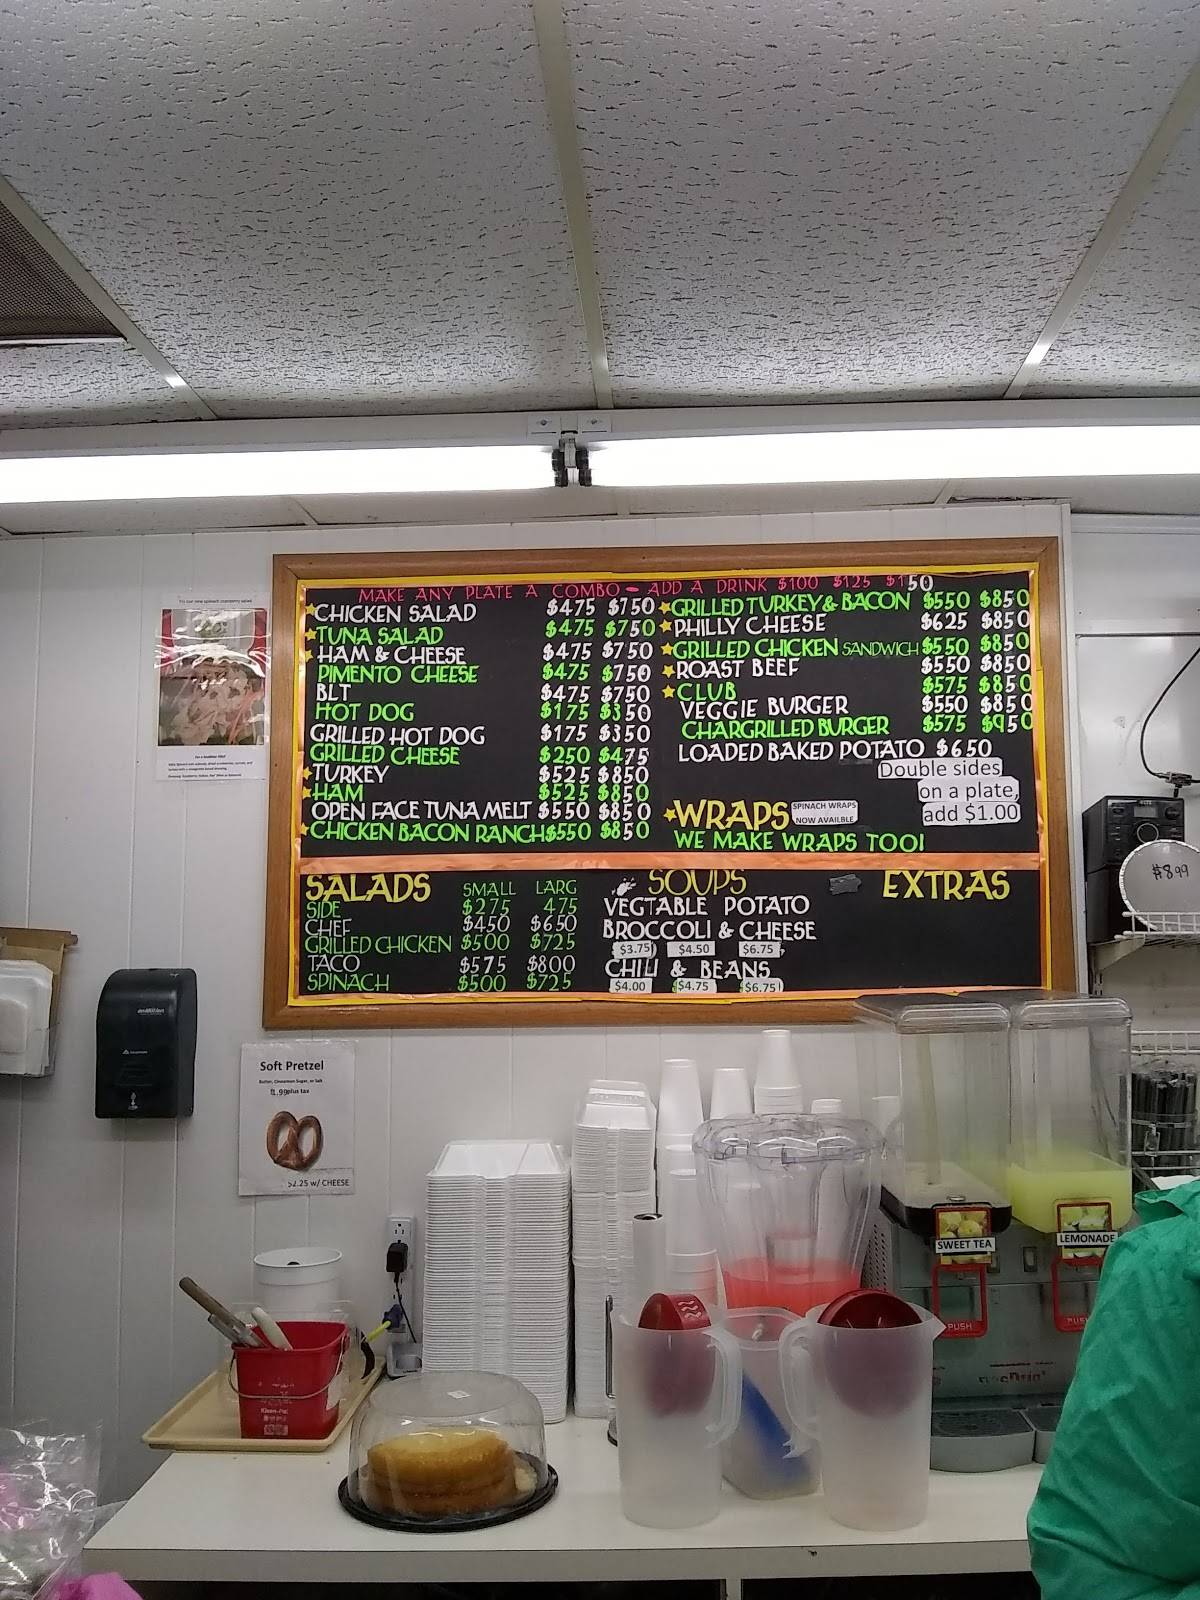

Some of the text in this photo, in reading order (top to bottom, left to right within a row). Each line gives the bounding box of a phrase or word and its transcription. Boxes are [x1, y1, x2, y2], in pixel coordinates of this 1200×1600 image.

[358, 576, 871, 602] MAKE ANY PLATE A COMBO ADD A DRINK $100 $125
[314, 596, 656, 623] CHICKEN SALAD $475 $750
[671, 588, 1029, 617] GRILLED TURKEY & BACON $550 $850
[318, 618, 656, 645] TUNA SALAD $475 $750
[674, 609, 1030, 638] PHILLY CHEESE $625 $850
[318, 640, 654, 665] HAM & CHEESE $475 $750
[672, 631, 1030, 660] GRILLED CHICKEN SANDWICH $550 $850
[317, 661, 652, 684] PIMENTO CHEESE $475 $750
[676, 653, 1031, 680] ROAST BEEF $550 $850
[316, 682, 651, 703] BLT $475 $750
[676, 675, 968, 702] CLUB $575
[315, 701, 652, 722] HOT DOG $175 $350
[679, 694, 969, 720] VEGGIE BURGER $550
[310, 723, 651, 746] GRILLED HOT DOG $175 $350
[681, 713, 968, 740] CHARGRILLED BURGER $575
[310, 744, 591, 765] GRILLED CHEESE $250
[678, 738, 993, 763] LOADED BAKED POTATO $650
[312, 764, 650, 784] TURKEY $525 $850
[880, 758, 1001, 778] Double sides
[312, 783, 650, 804] HAM $525 $850
[919, 781, 1019, 801] on a plate,
[311, 801, 652, 821] OPEN FACE TUNA MELT $550 $850
[673, 799, 790, 831] WRAPS
[792, 801, 857, 810] SPINACH WRAPS
[924, 803, 1018, 823] add $1.00
[795, 815, 854, 824] NOW AVAILBLE
[309, 820, 650, 844] CHICKEN BACON RANCH $550 $850
[673, 830, 858, 852] WE MAKE WRAPS
[305, 873, 577, 903] SALADS SMALL LARG
[648, 868, 1010, 901] SOUPS EXTRAS
[306, 897, 577, 919] SIDE $275 475
[603, 895, 810, 917] VEGTABLE POTATO
[305, 914, 578, 938] CHEF $450 $650
[602, 919, 817, 942] BROCCOLI & CHEESE
[304, 932, 576, 955] GRILLED CHICKEN $500 $725
[620, 943, 774, 955] $3.75 $4.50 $6.75
[308, 954, 576, 974] TACO $575 $800
[670, 959, 687, 978] &
[700, 959, 771, 979] BEANS
[307, 972, 572, 992] SPINACH $500 $725
[615, 979, 776, 993] $4.00 $4.75 $6.75
[260, 1059, 324, 1071] Soft Pretzel
[310, 1179, 320, 1187] w/
[322, 1178, 350, 1187] CHEESE
[937, 1239, 992, 1250] SWEET TEA
[1059, 1233, 1115, 1243] LEMONADE
[947, 1323, 972, 1331] PUSH
